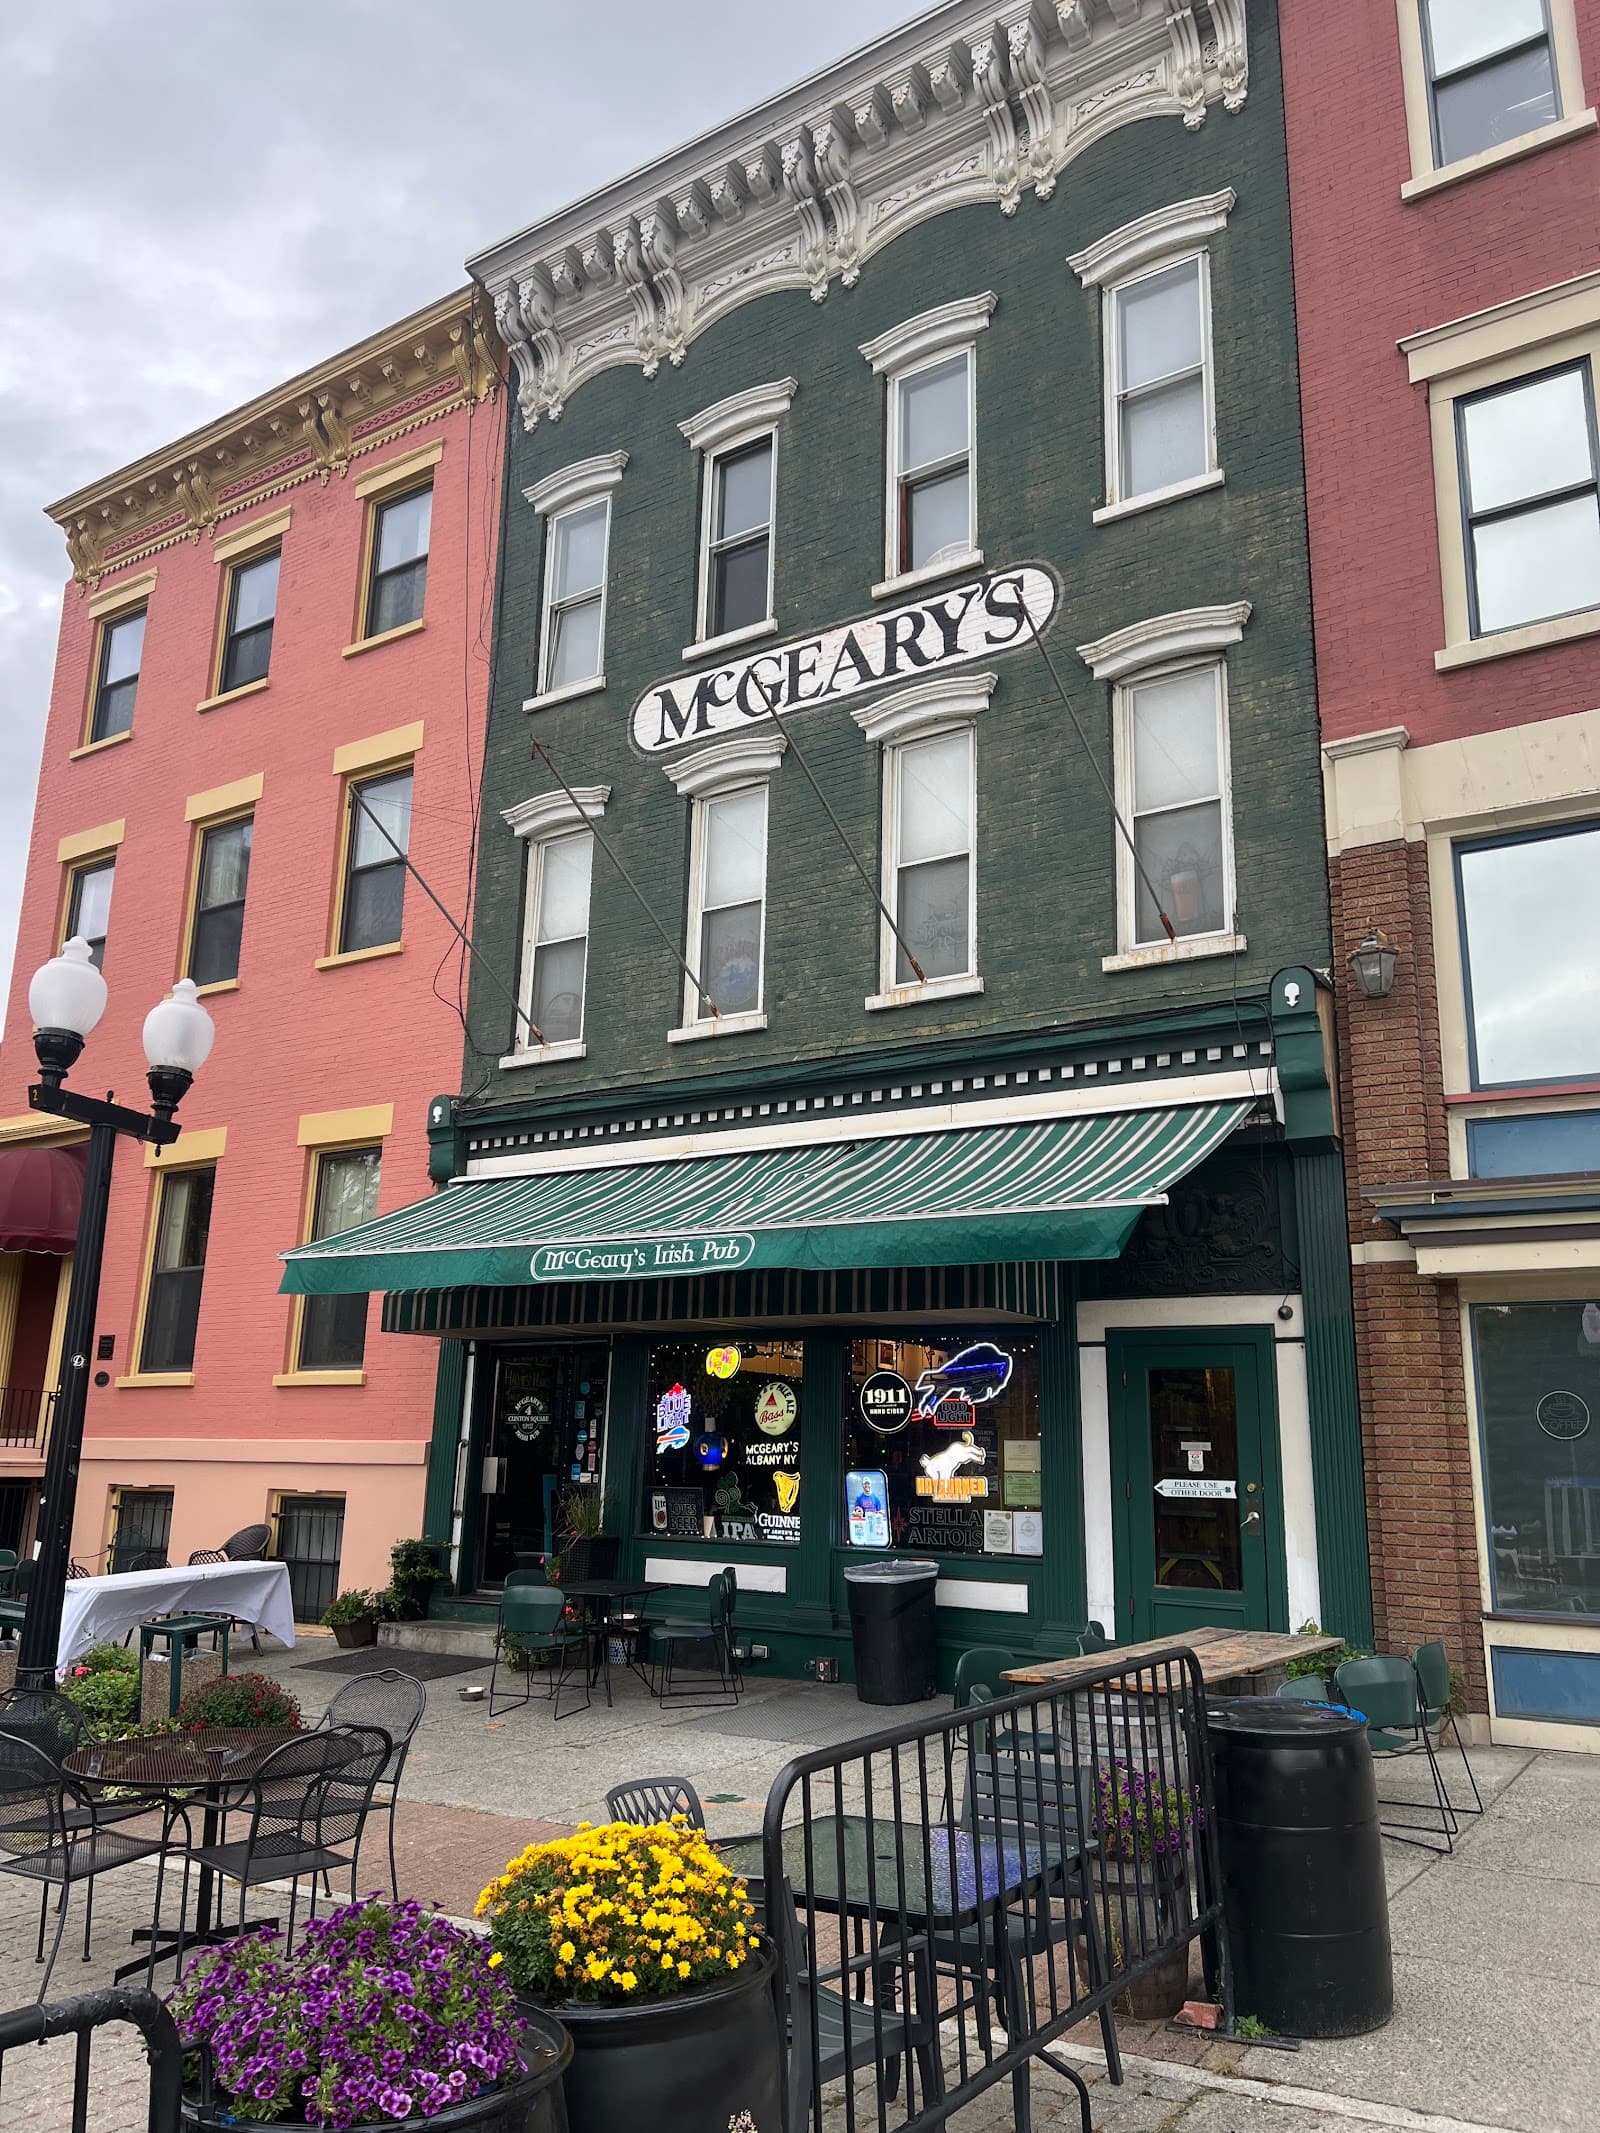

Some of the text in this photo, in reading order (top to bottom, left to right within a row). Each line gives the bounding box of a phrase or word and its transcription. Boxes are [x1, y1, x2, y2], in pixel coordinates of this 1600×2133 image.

[542, 1239, 741, 1274] McGeary's Irish Pub
[776, 1383, 794, 1415] PALE ALE
[864, 1387, 908, 1404] 1911
[524, 1405, 532, 1416] 4
[657, 1393, 692, 1417] BLUE
[941, 1401, 968, 1413] BUD
[656, 1409, 692, 1433] LIGHT
[759, 1408, 785, 1425] Bass
[937, 1411, 973, 1423] LIGHT
[745, 1455, 797, 1466] ALBANY NY
[1174, 1480, 1201, 1488] PLEASE
[1170, 1489, 1199, 1497] OTHER
[669, 1515, 699, 1531] BEER
[908, 1505, 983, 1528] STELLA
[721, 1521, 756, 1541] IPA
[908, 1527, 984, 1548] ARTOIS
